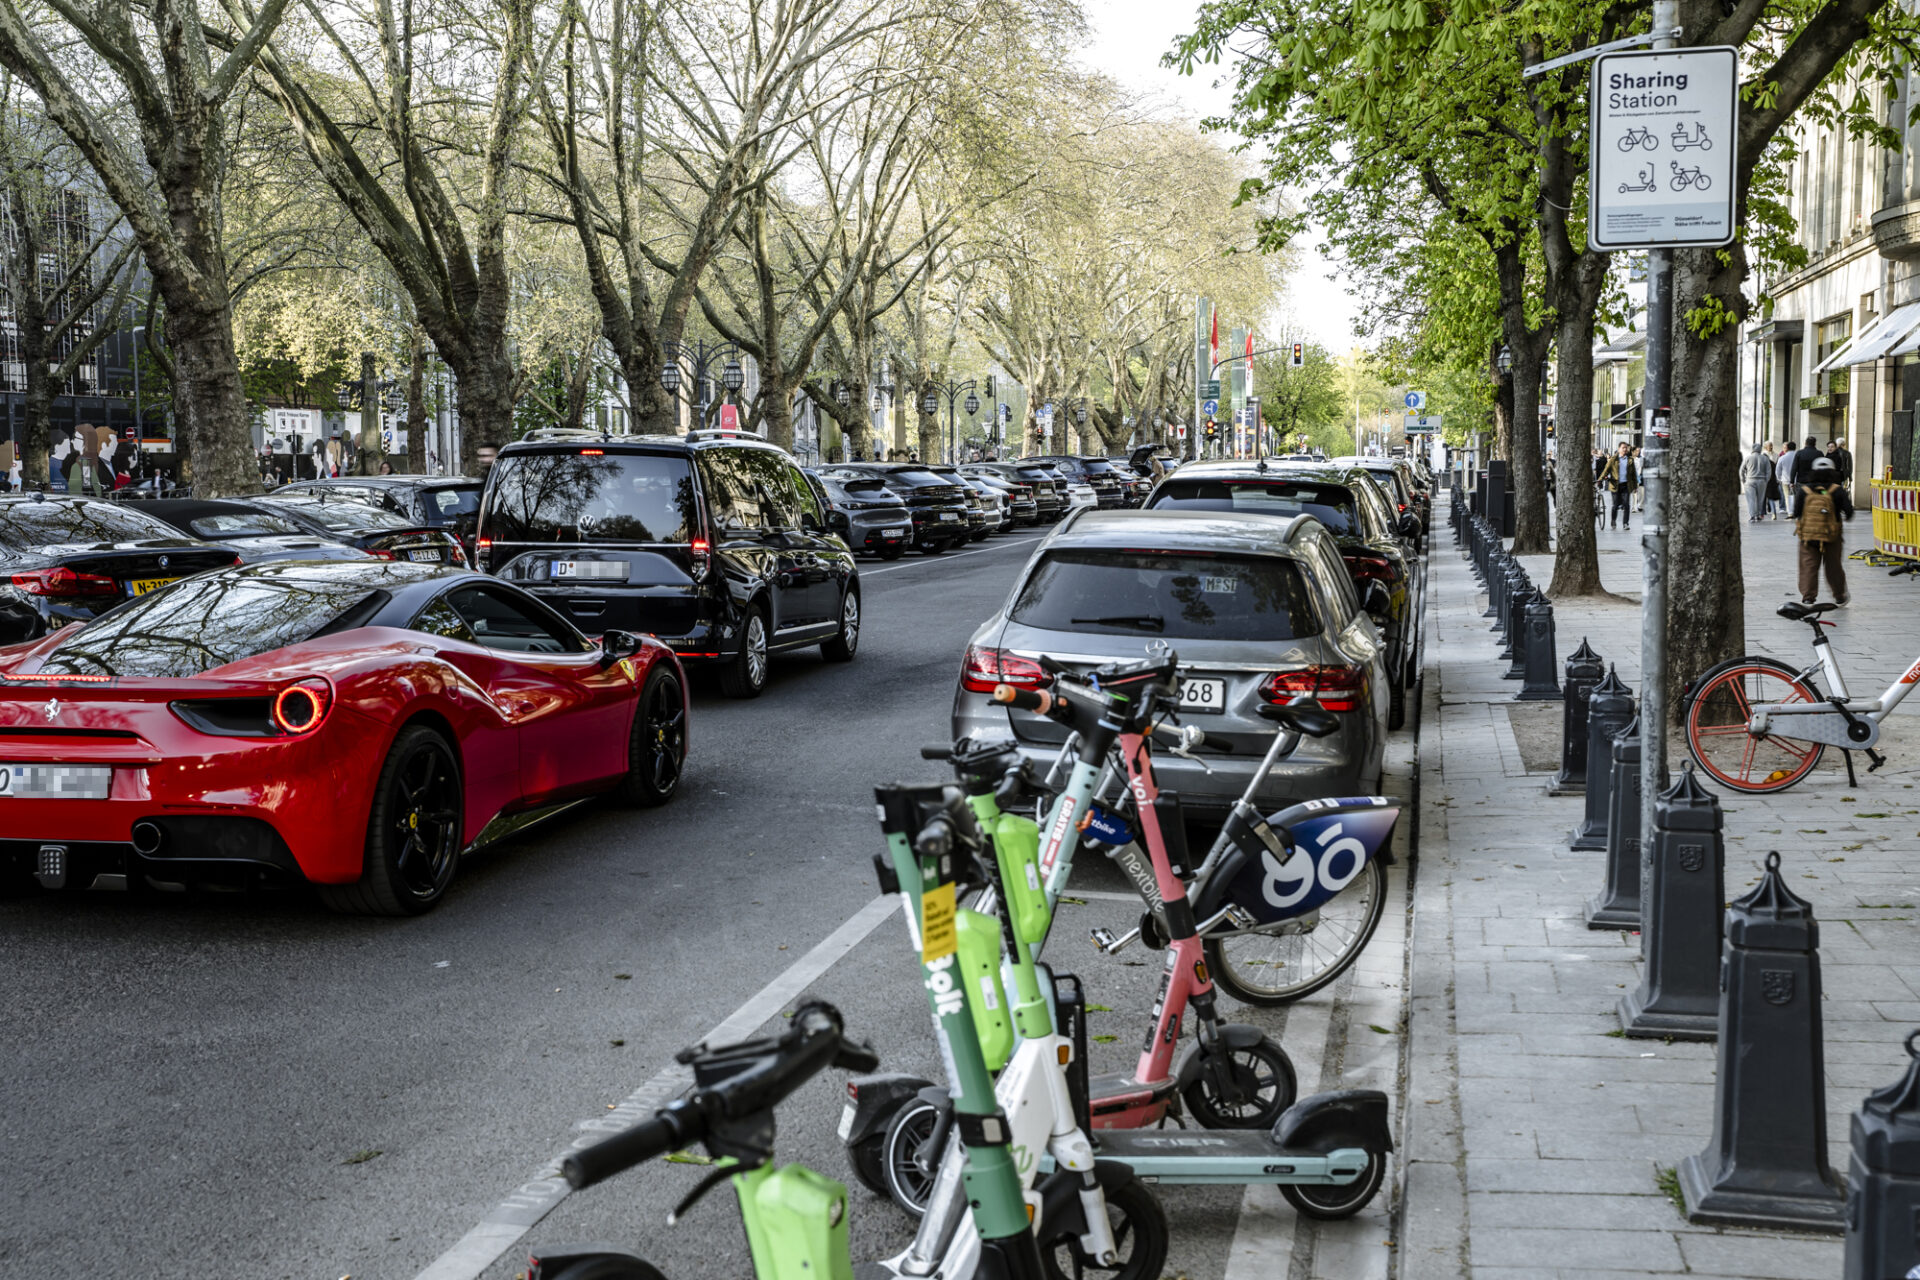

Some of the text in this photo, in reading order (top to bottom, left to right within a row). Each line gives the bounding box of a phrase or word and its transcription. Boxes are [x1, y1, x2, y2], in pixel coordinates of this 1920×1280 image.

[1610, 71, 1688, 90] Sharing
[1609, 91, 1677, 109] Station
[559, 563, 567, 575] D
[1051, 799, 1075, 842] GRATIS
[1091, 819, 1117, 835] tbike
[1122, 852, 1165, 913] nextbike
[1142, 1137, 1228, 1147] TIER
